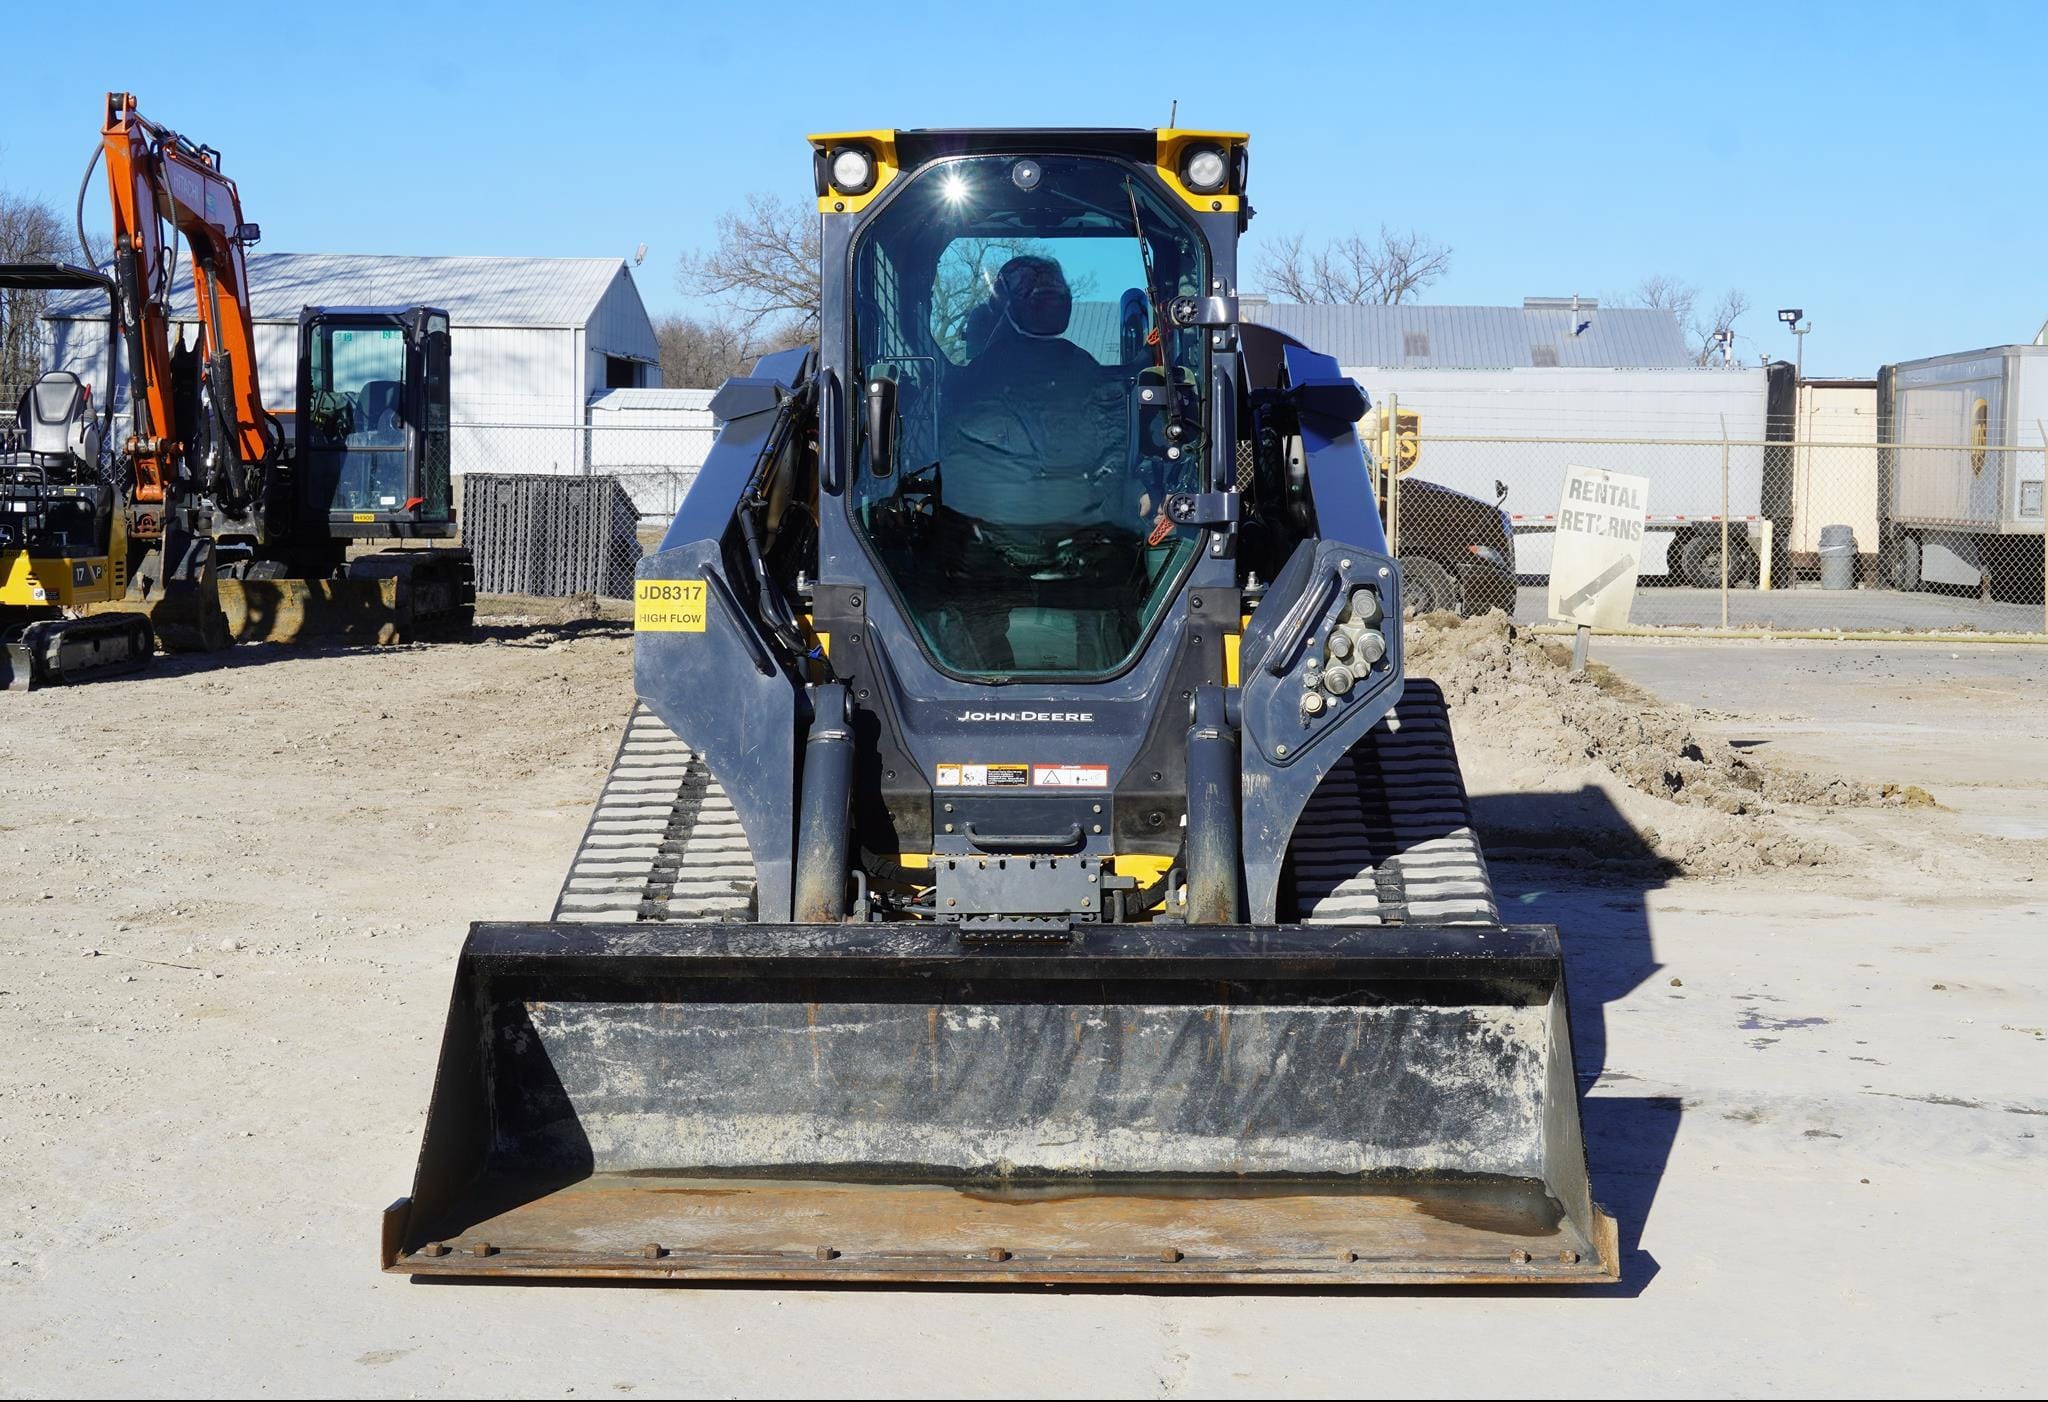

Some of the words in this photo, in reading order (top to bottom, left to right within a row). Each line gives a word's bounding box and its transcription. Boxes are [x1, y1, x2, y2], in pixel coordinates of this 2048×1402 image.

[1569, 479, 1640, 510] RENTAL
[77, 567, 85, 581] 17
[640, 586, 702, 600] JD8317
[640, 614, 667, 623] HIGH
[670, 614, 702, 623] FLOW
[957, 711, 1016, 721] JOHN
[1021, 711, 1093, 721] DEERE
